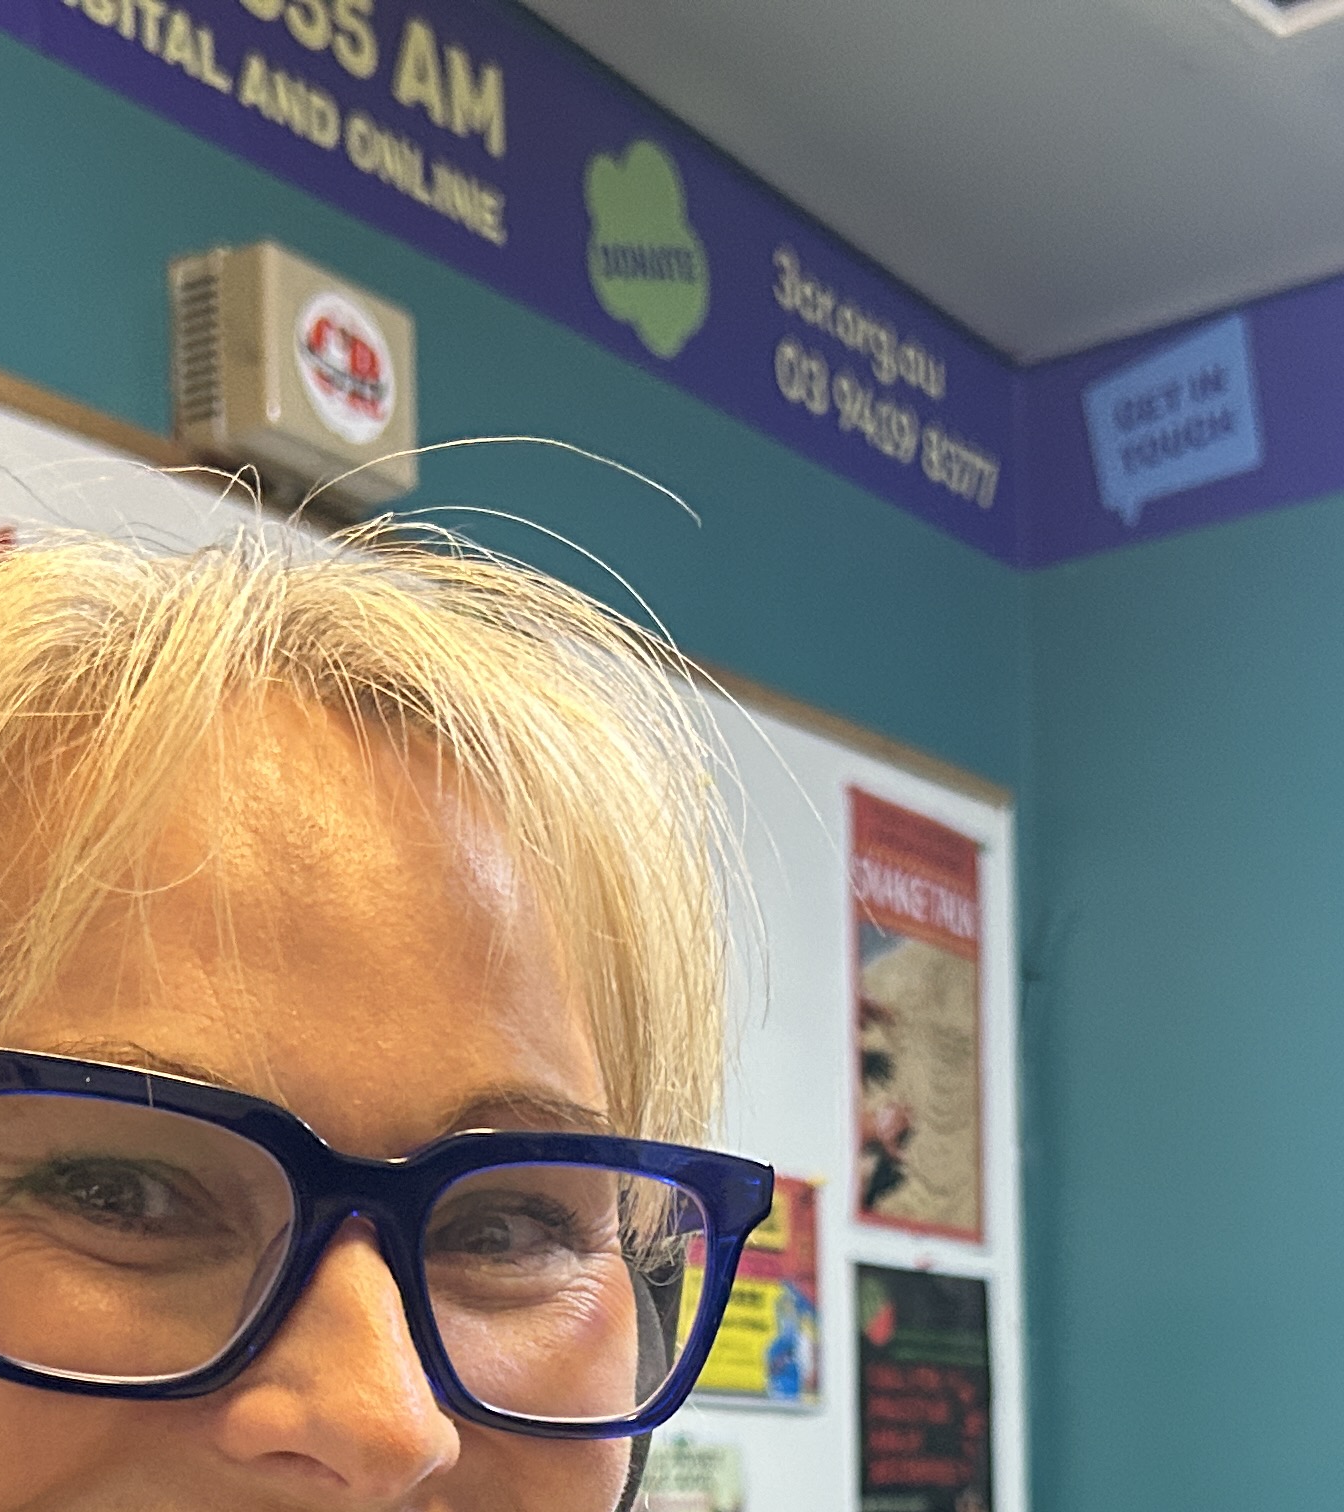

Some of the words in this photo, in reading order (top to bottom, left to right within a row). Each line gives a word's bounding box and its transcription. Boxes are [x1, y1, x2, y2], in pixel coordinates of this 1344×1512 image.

[67, 0, 233, 96] GITAL
[236, 50, 342, 151] AND
[343, 109, 509, 248] ONLINE
[237, 0, 381, 80] 55
[392, 17, 506, 160] AM
[773, 335, 830, 417] 03
